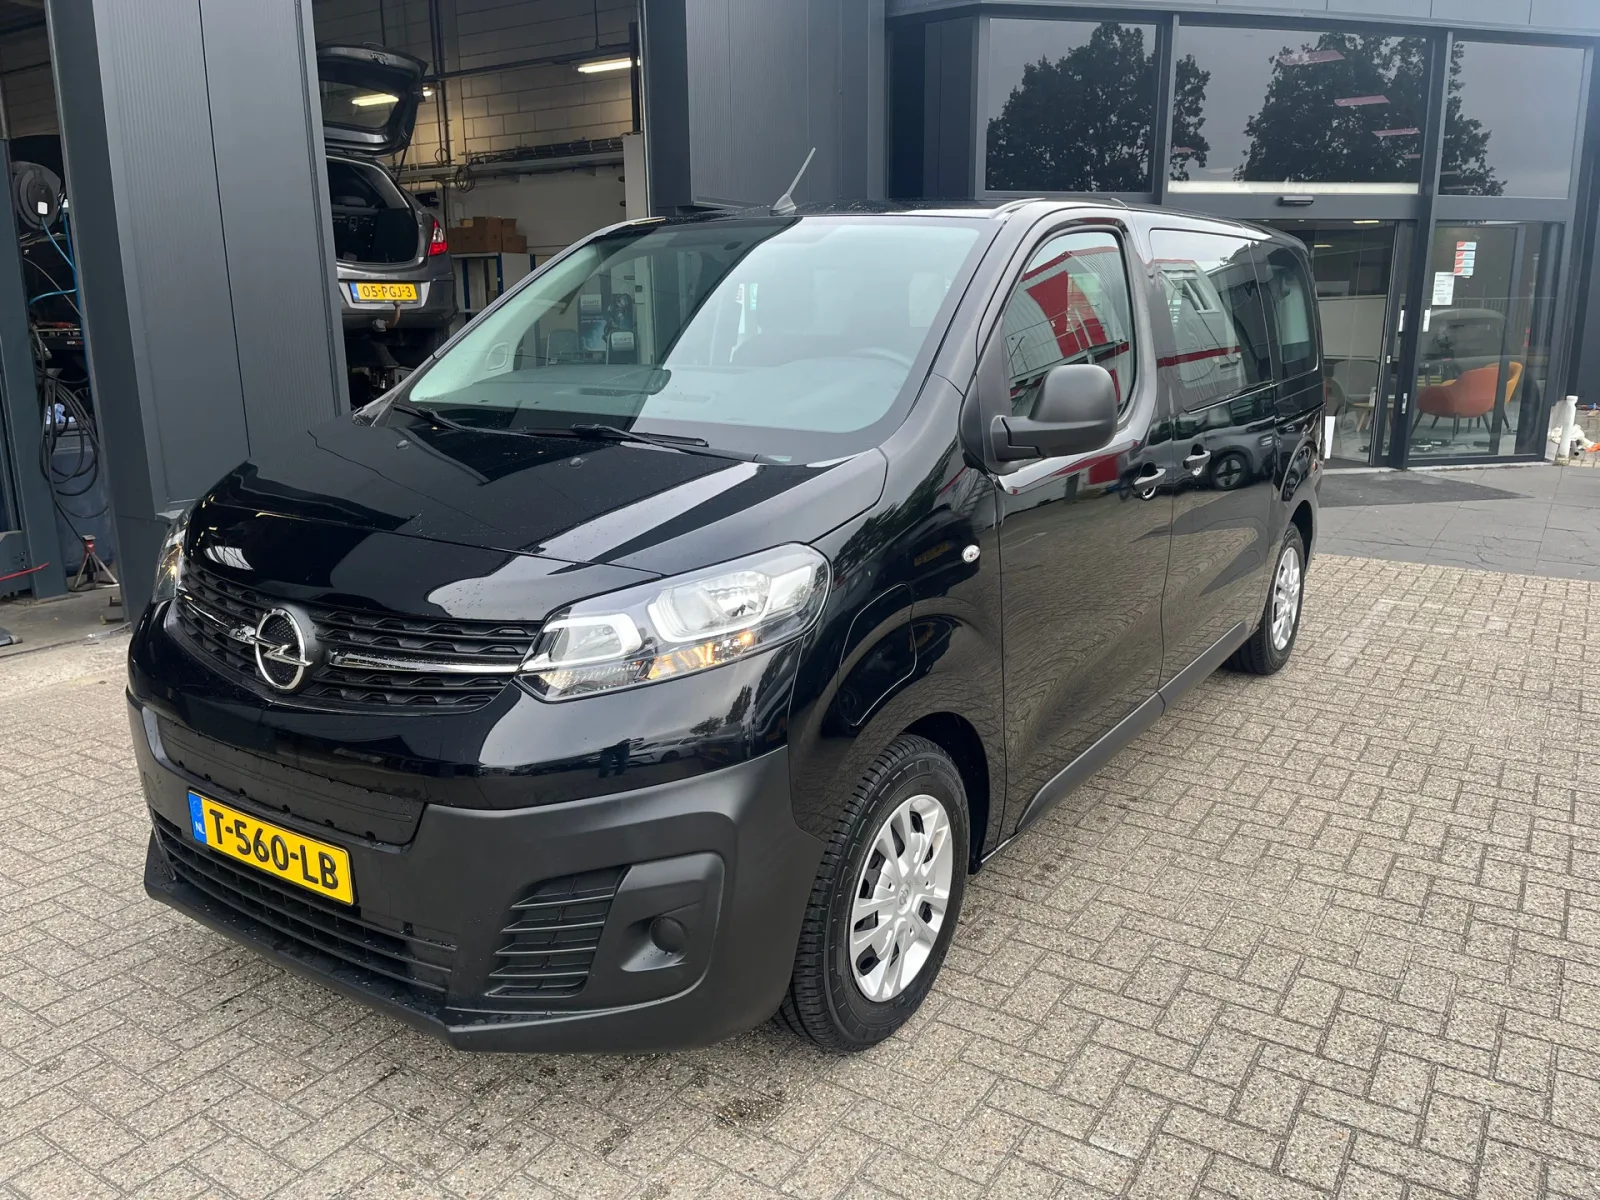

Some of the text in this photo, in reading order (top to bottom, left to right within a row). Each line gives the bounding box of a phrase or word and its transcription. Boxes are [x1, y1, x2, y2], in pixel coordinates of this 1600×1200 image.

[362, 285, 412, 298] 05-PGJ-3
[195, 821, 205, 834] NL
[209, 808, 339, 890] T-560-LB
